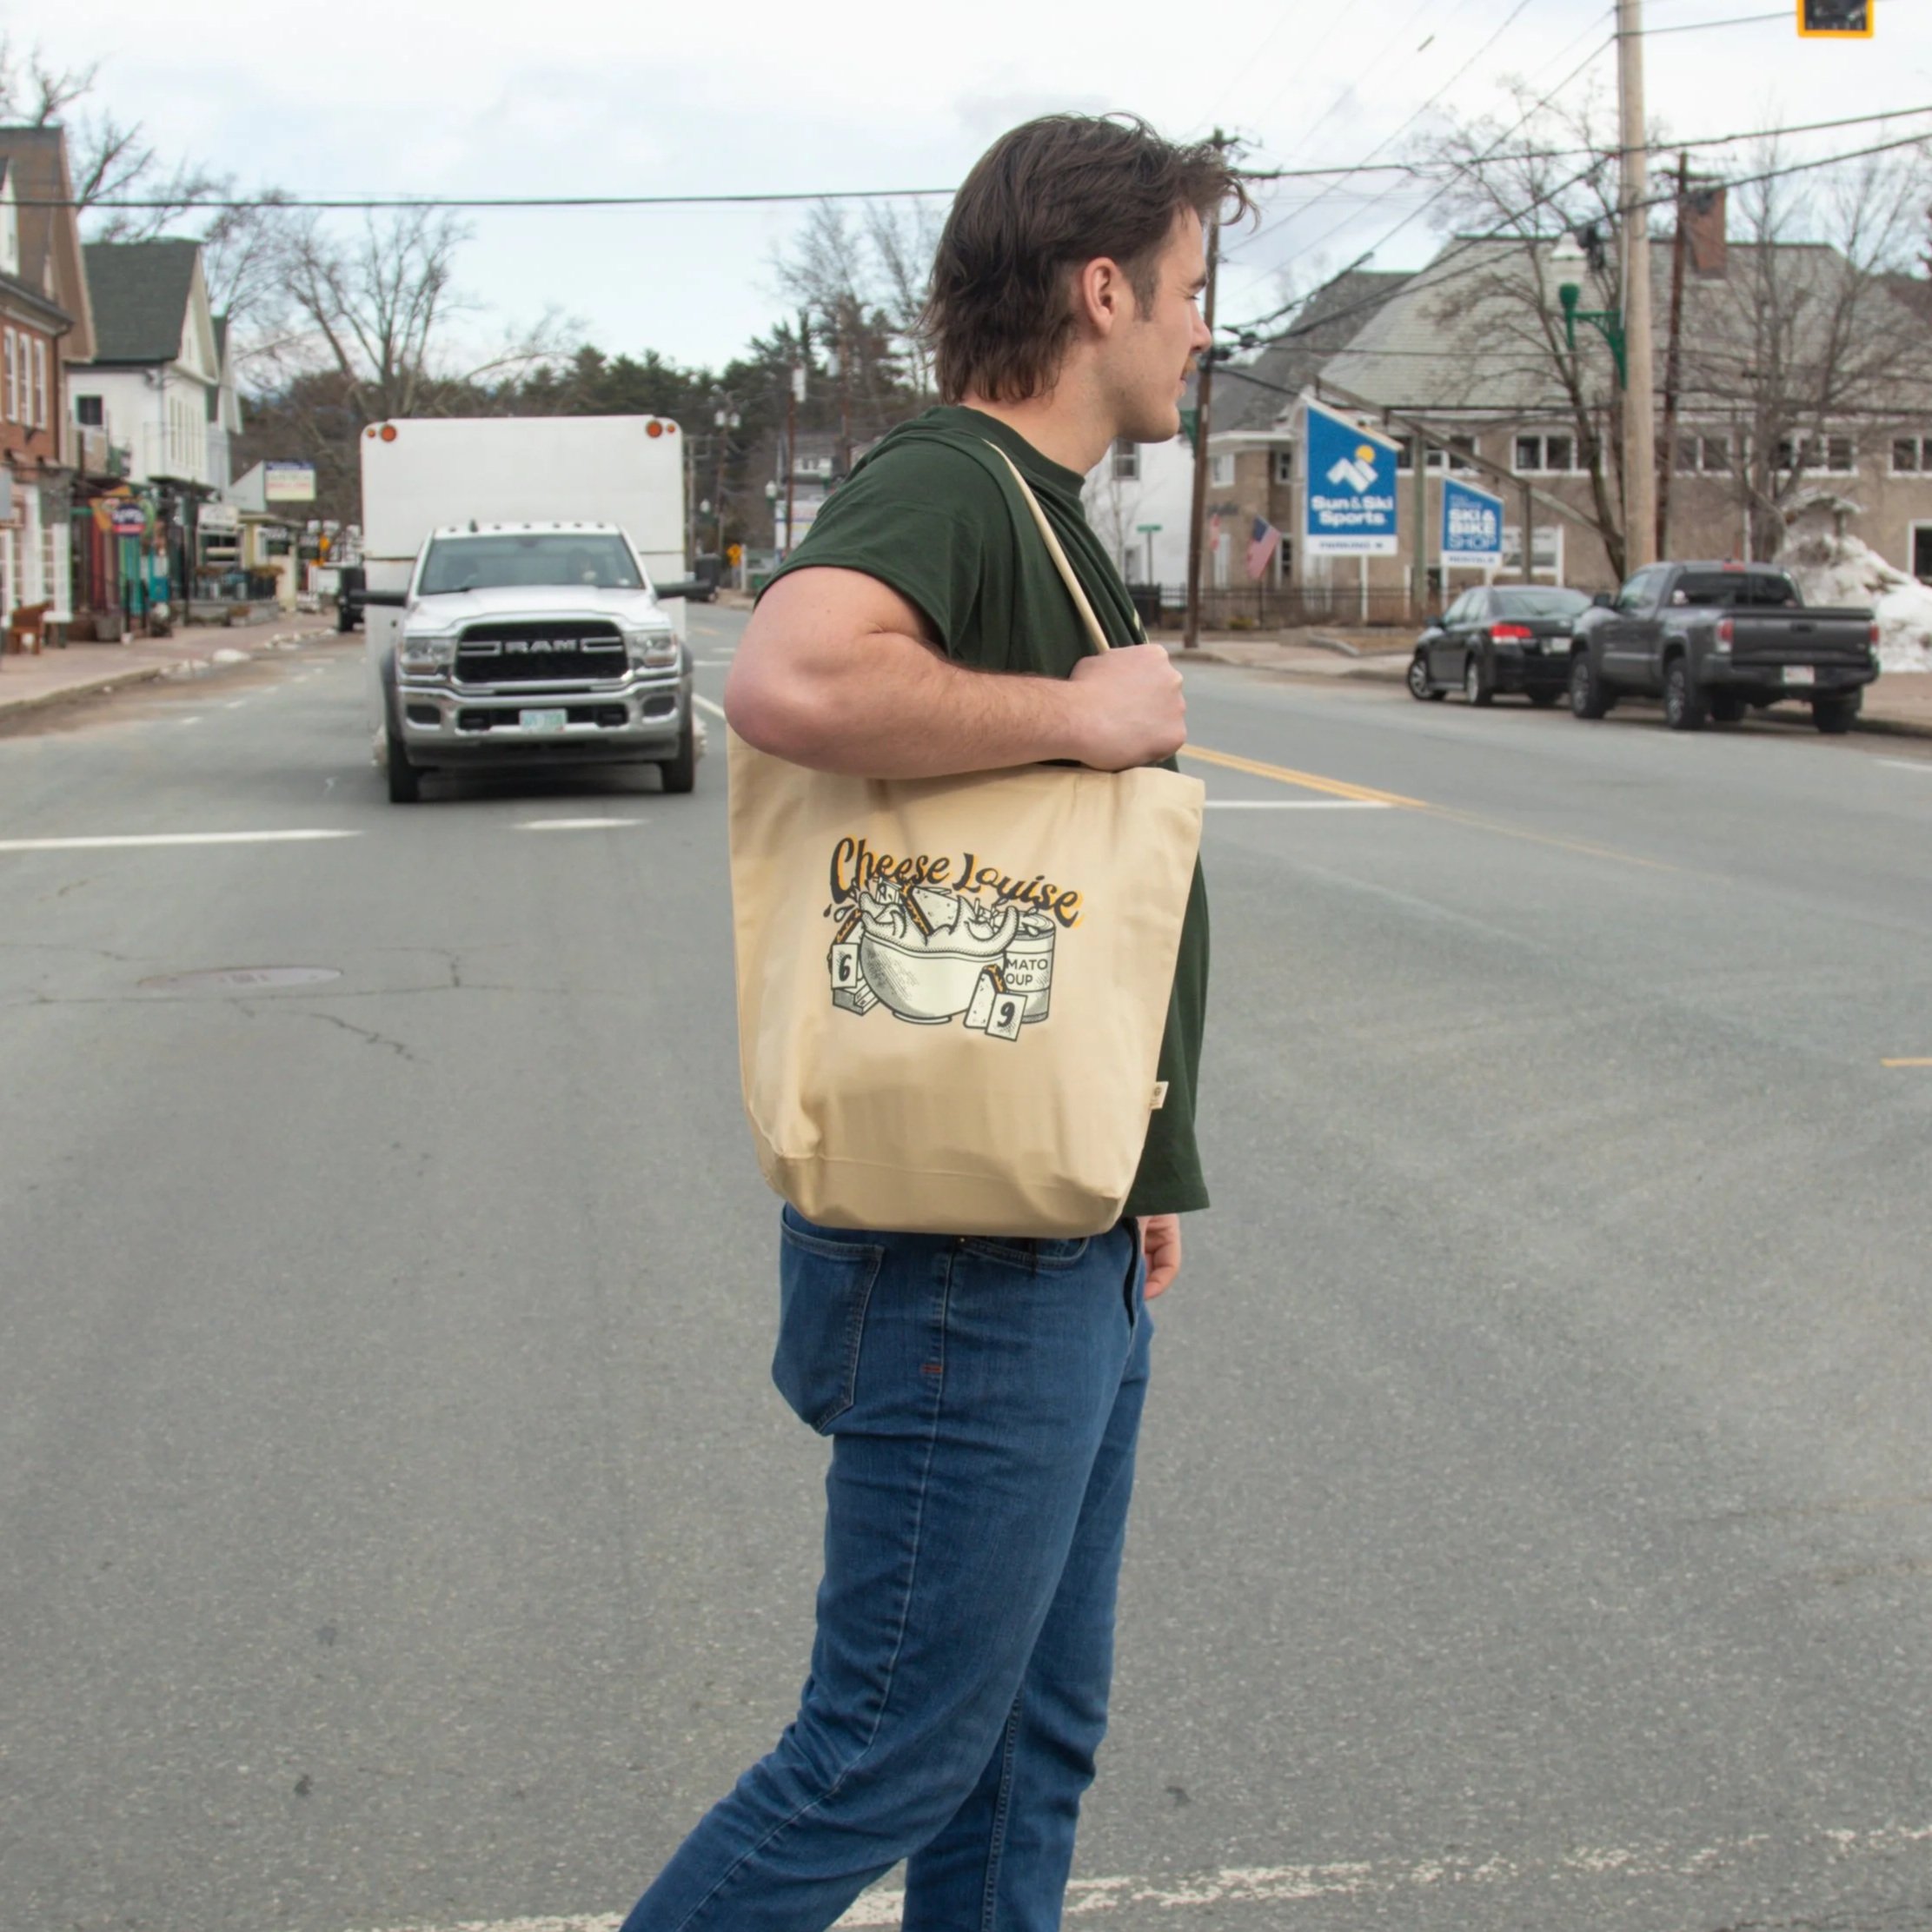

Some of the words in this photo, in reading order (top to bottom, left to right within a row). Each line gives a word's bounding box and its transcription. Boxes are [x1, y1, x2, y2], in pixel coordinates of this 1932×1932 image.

[1311, 495, 1349, 511] Sun
[1362, 495, 1393, 511] Ski
[1319, 510, 1385, 528] Sports
[1448, 508, 1481, 521] SKI
[1448, 521, 1497, 534] BIKE
[1448, 534, 1497, 549] SHOP
[504, 639, 577, 654] RAM
[829, 835, 952, 905] Cheese
[952, 851, 1085, 929] Louise
[838, 954, 853, 982] 6
[1005, 959, 1048, 971] MATO
[1005, 973, 1033, 986] OUP
[996, 1001, 1015, 1028] 9
